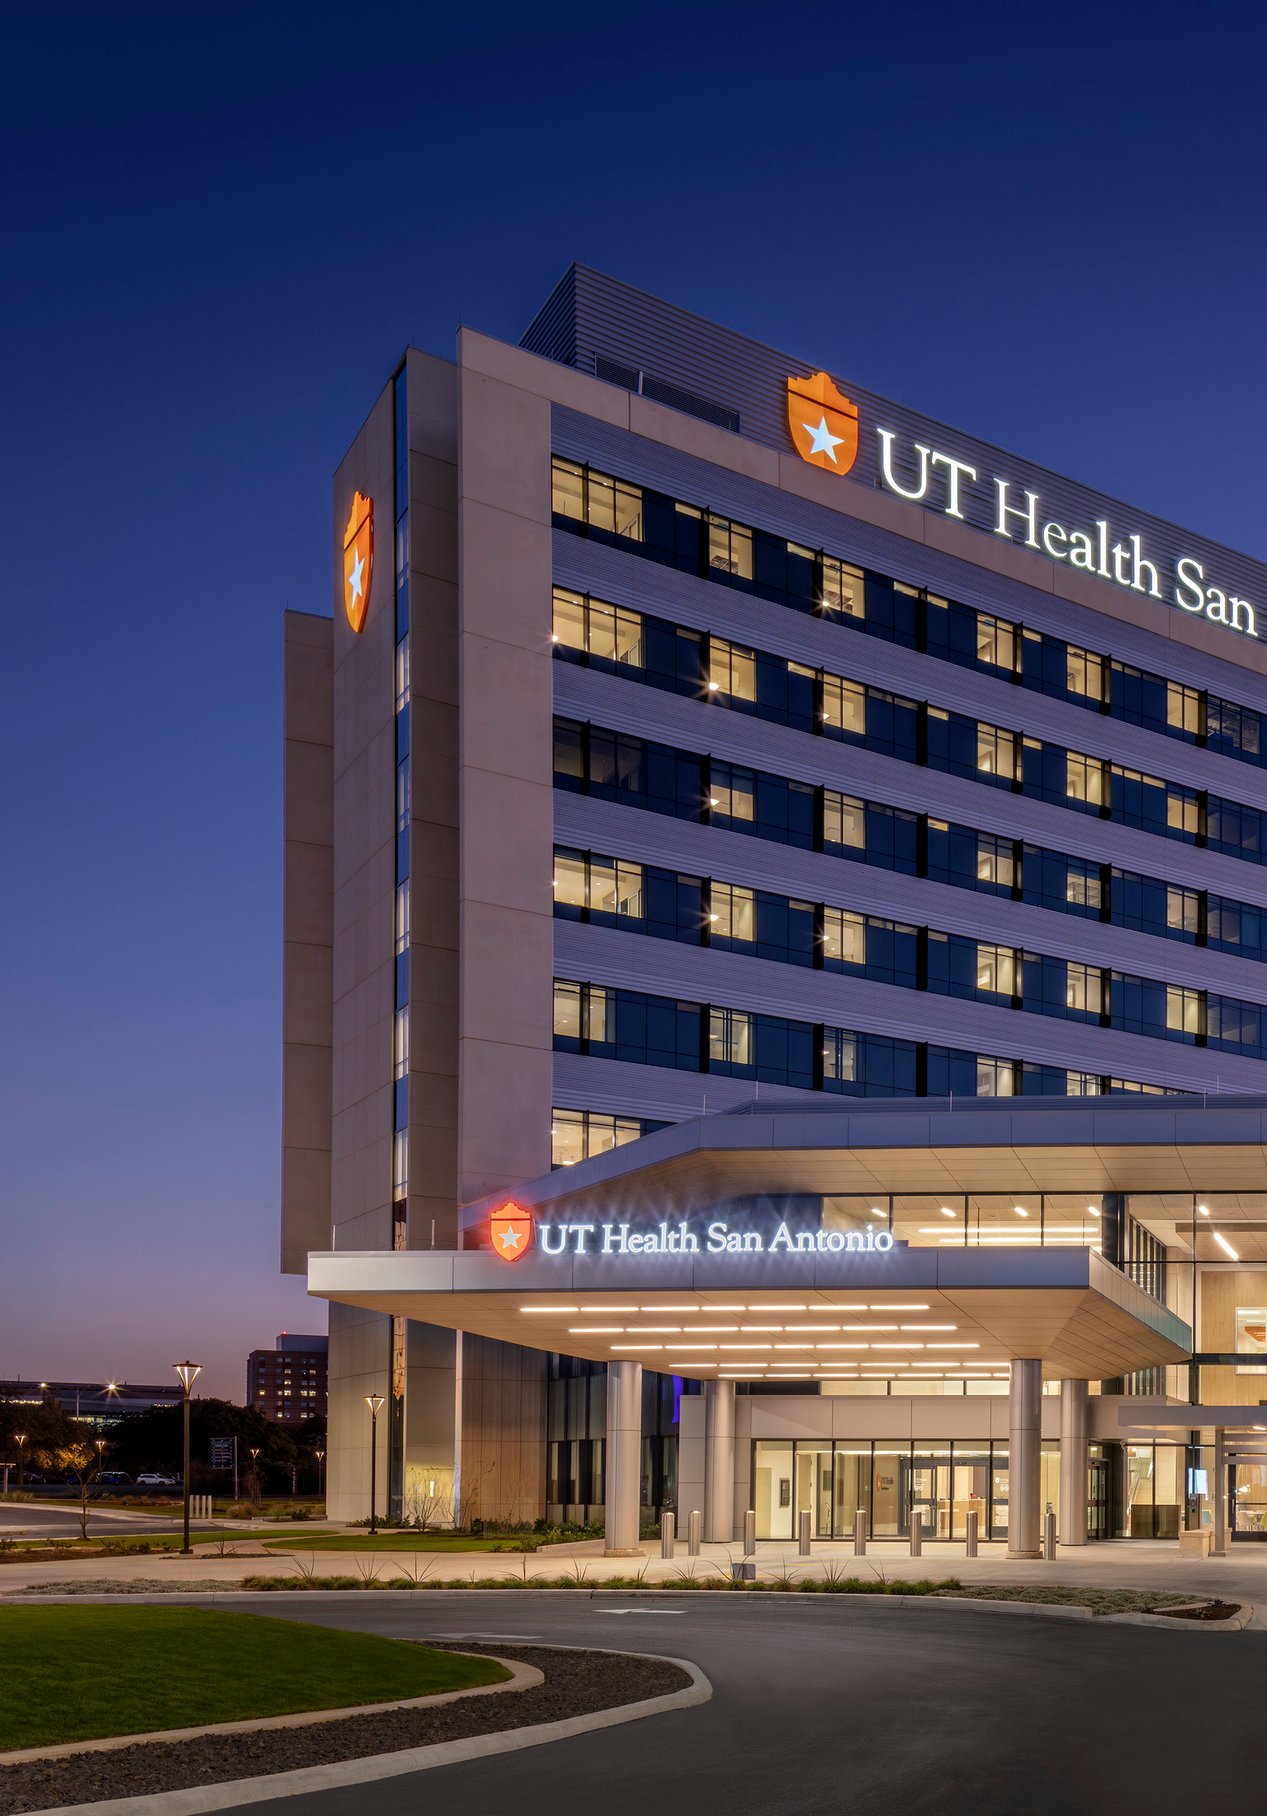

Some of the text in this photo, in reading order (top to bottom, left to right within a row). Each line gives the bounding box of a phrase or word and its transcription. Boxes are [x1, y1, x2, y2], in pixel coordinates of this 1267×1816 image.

[876, 427, 977, 519] UT
[993, 477, 1163, 599] Health
[1175, 557, 1259, 638] San
[538, 1221, 894, 1255] UT Health San Antonio
